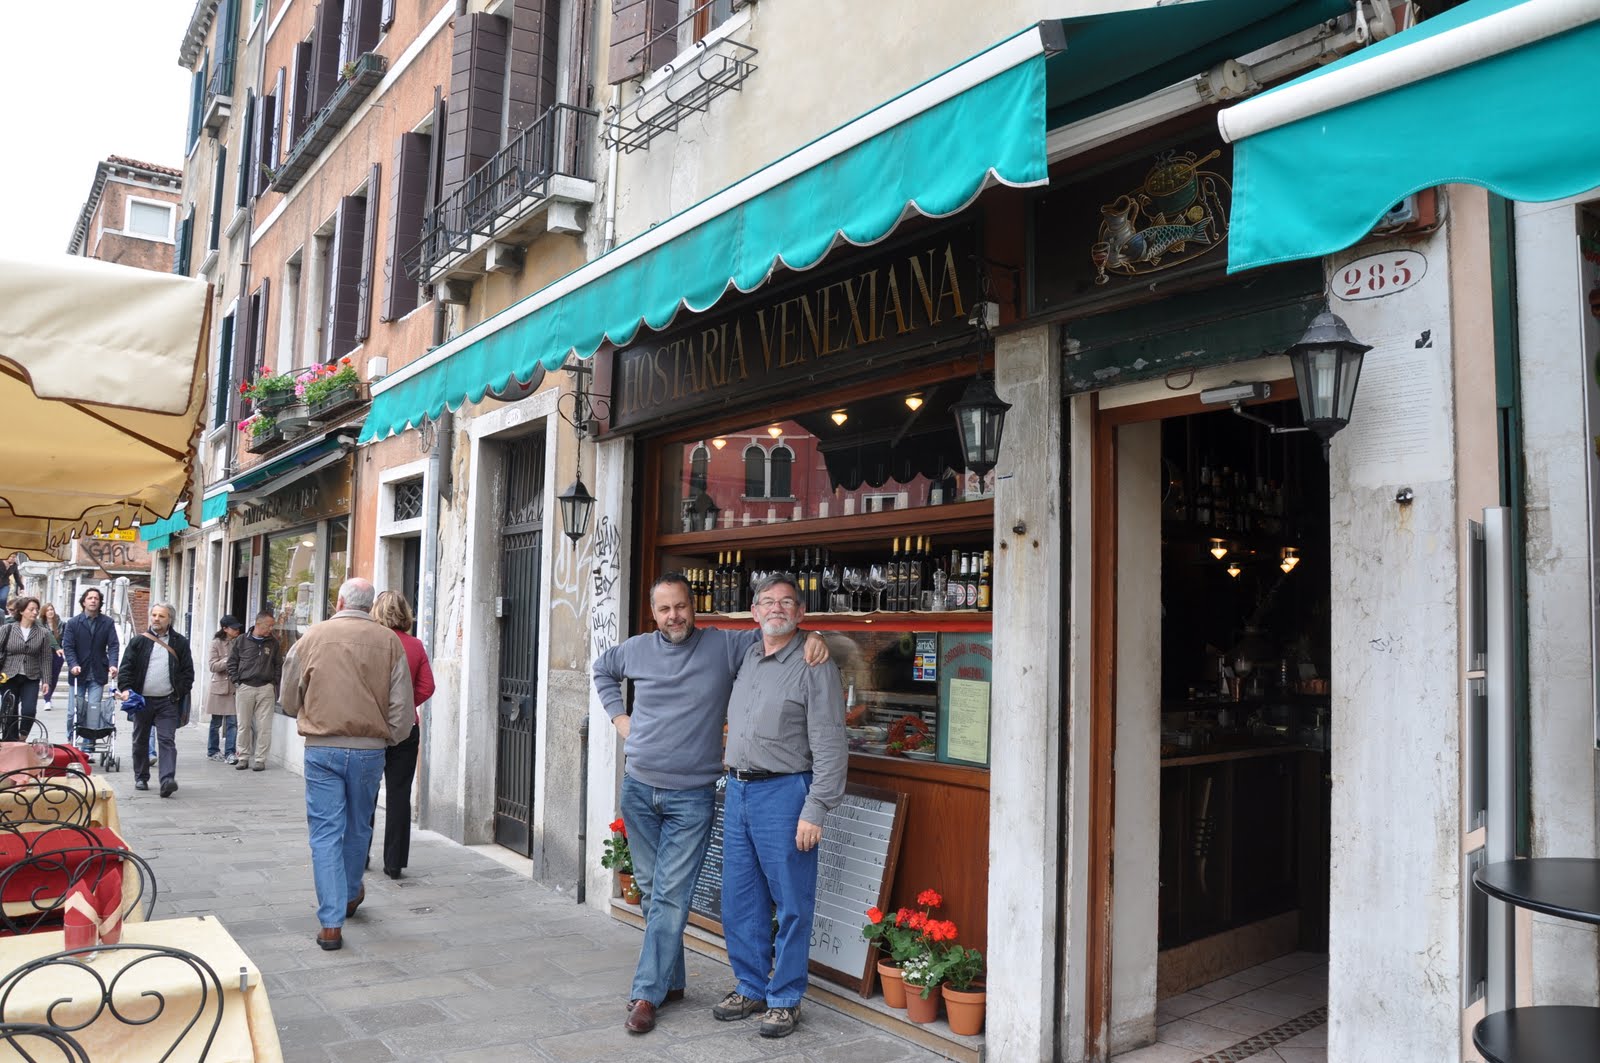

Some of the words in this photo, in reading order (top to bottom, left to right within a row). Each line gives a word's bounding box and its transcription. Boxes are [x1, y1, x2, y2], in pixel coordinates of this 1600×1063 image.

[1344, 258, 1411, 296] 285
[620, 318, 749, 416] HOSTARIA
[757, 241, 966, 373] VENEXIANA
[814, 914, 834, 932] DWICH
[809, 928, 843, 955] BAR
